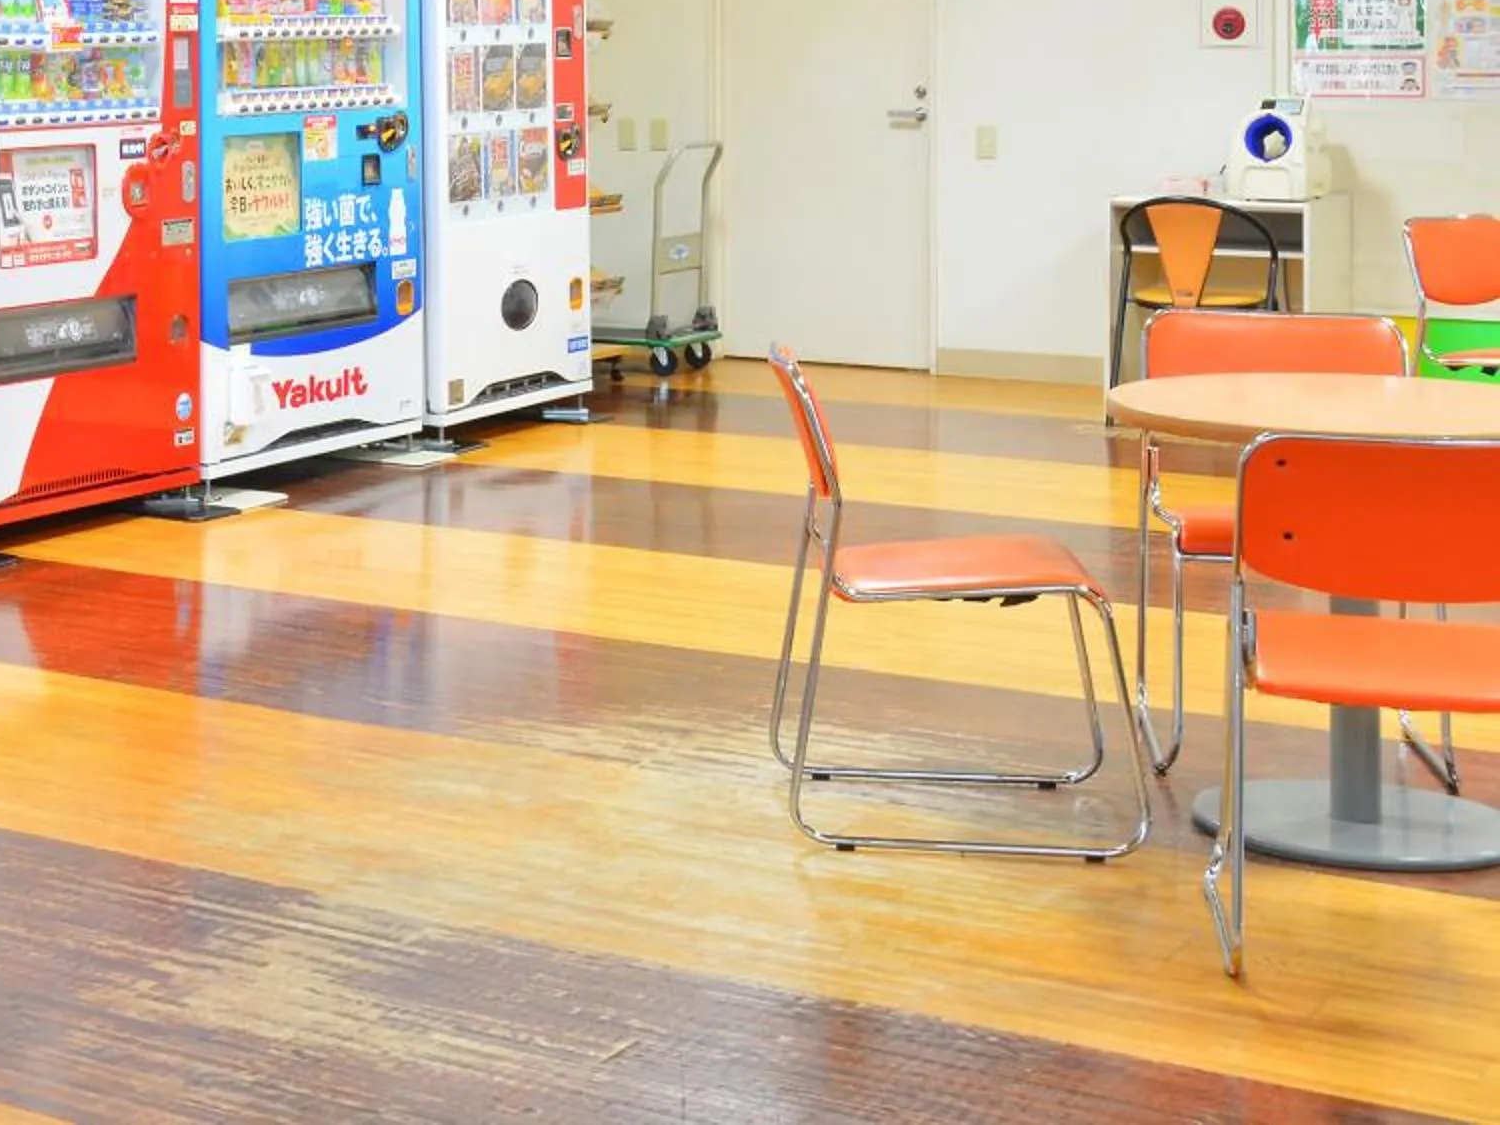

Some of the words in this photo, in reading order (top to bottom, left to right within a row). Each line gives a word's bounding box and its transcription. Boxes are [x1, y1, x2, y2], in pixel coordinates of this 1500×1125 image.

[304, 192, 378, 232] 強い菌で、
[304, 229, 389, 268] 強く生きる。
[272, 366, 368, 409] Yakult
